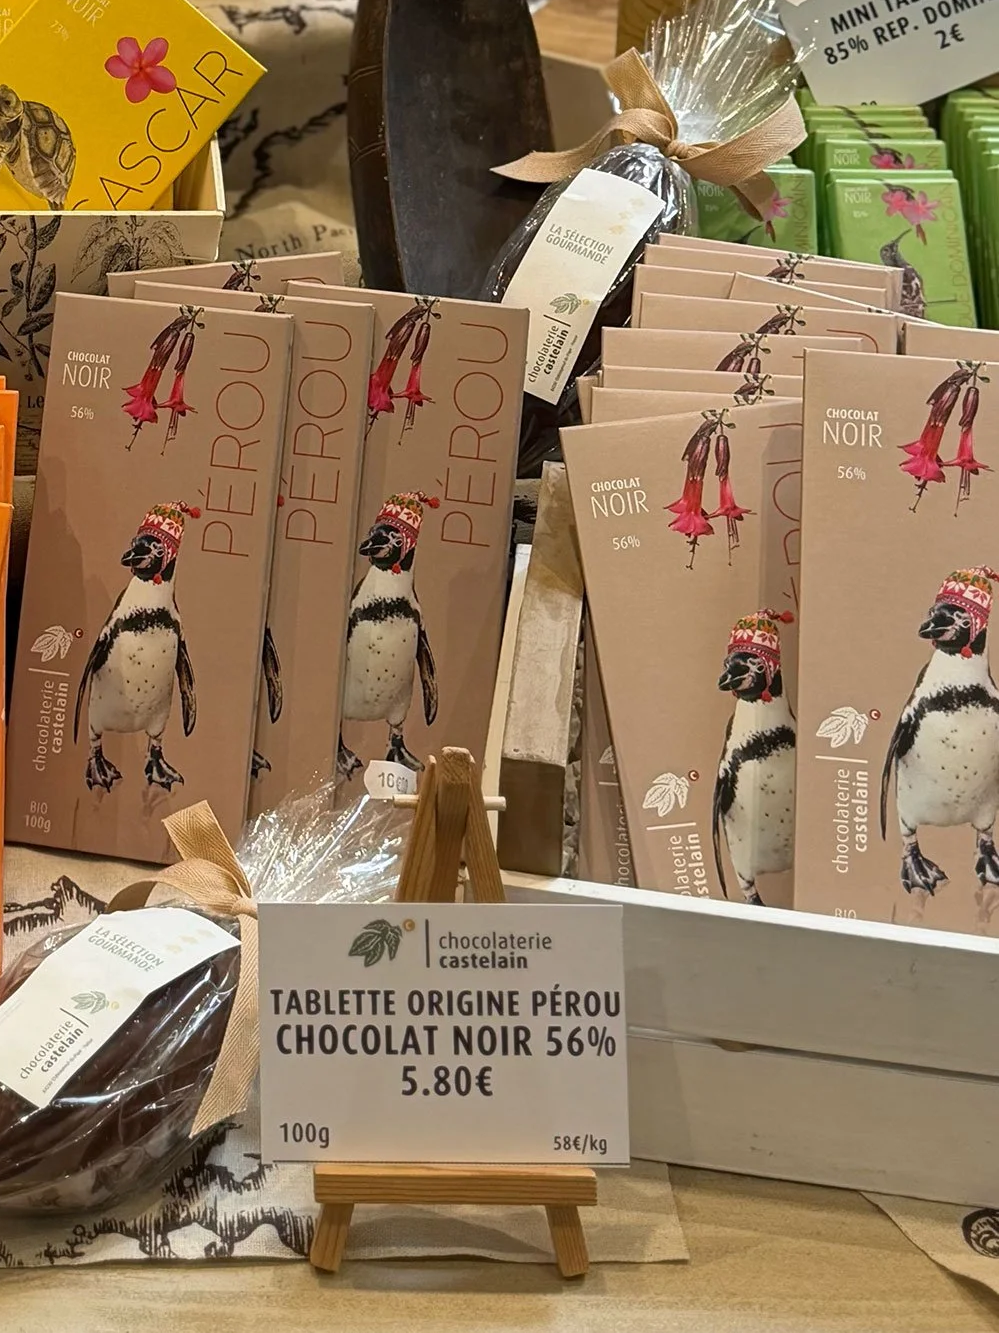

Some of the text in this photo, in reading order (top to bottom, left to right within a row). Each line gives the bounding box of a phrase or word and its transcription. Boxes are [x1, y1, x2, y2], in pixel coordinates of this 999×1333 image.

[830, 1, 880, 35] MINI
[823, 37, 870, 66] 85%
[872, 18, 919, 46] REP.
[934, 23, 966, 50] 2€
[834, 153, 861, 166] NOIR
[697, 185, 724, 197] NOIR
[844, 190, 872, 204] NOIR
[235, 224, 354, 262] North Pac
[545, 234, 609, 265] GOURMANDE
[548, 224, 615, 255] LA SÉLECTION
[67, 350, 112, 366] CHOCOLAT
[528, 324, 559, 384] chocolaterie
[543, 328, 570, 376] castelain
[61, 363, 113, 391] NOIR
[69, 405, 95, 421] 56%
[826, 407, 879, 422] CHOCOLAT
[197, 330, 272, 559] PÉROU
[283, 320, 353, 546] PÉROU
[436, 321, 511, 548] PÉROU
[822, 420, 883, 449] NOIR
[591, 477, 641, 495] CHOCOLAT
[837, 466, 866, 481] 56%
[591, 490, 650, 520] NOIR
[611, 534, 642, 552] 56%
[33, 677, 55, 773] chocolaterie
[50, 680, 70, 754] castelain
[24, 814, 52, 834] 100g
[30, 800, 49, 815] BIO
[831, 767, 850, 874] chocolaterie
[851, 770, 869, 853] castelain
[688, 833, 711, 899] stelain
[87, 935, 156, 973] GOURMANDE
[95, 926, 165, 967] LA SÉLECTION
[438, 930, 553, 952] chocolaterie
[439, 951, 529, 970] castelain
[270, 983, 621, 1018] TABLETTE ORIGINE PÉROU
[20, 1019, 75, 1080] chocolaterie
[40, 1026, 85, 1074] castelain
[275, 1024, 618, 1058] CHOCOLAT NOIR 56%
[400, 1065, 494, 1098] 5.80€
[278, 1121, 609, 1155] 100g 58€/kg
